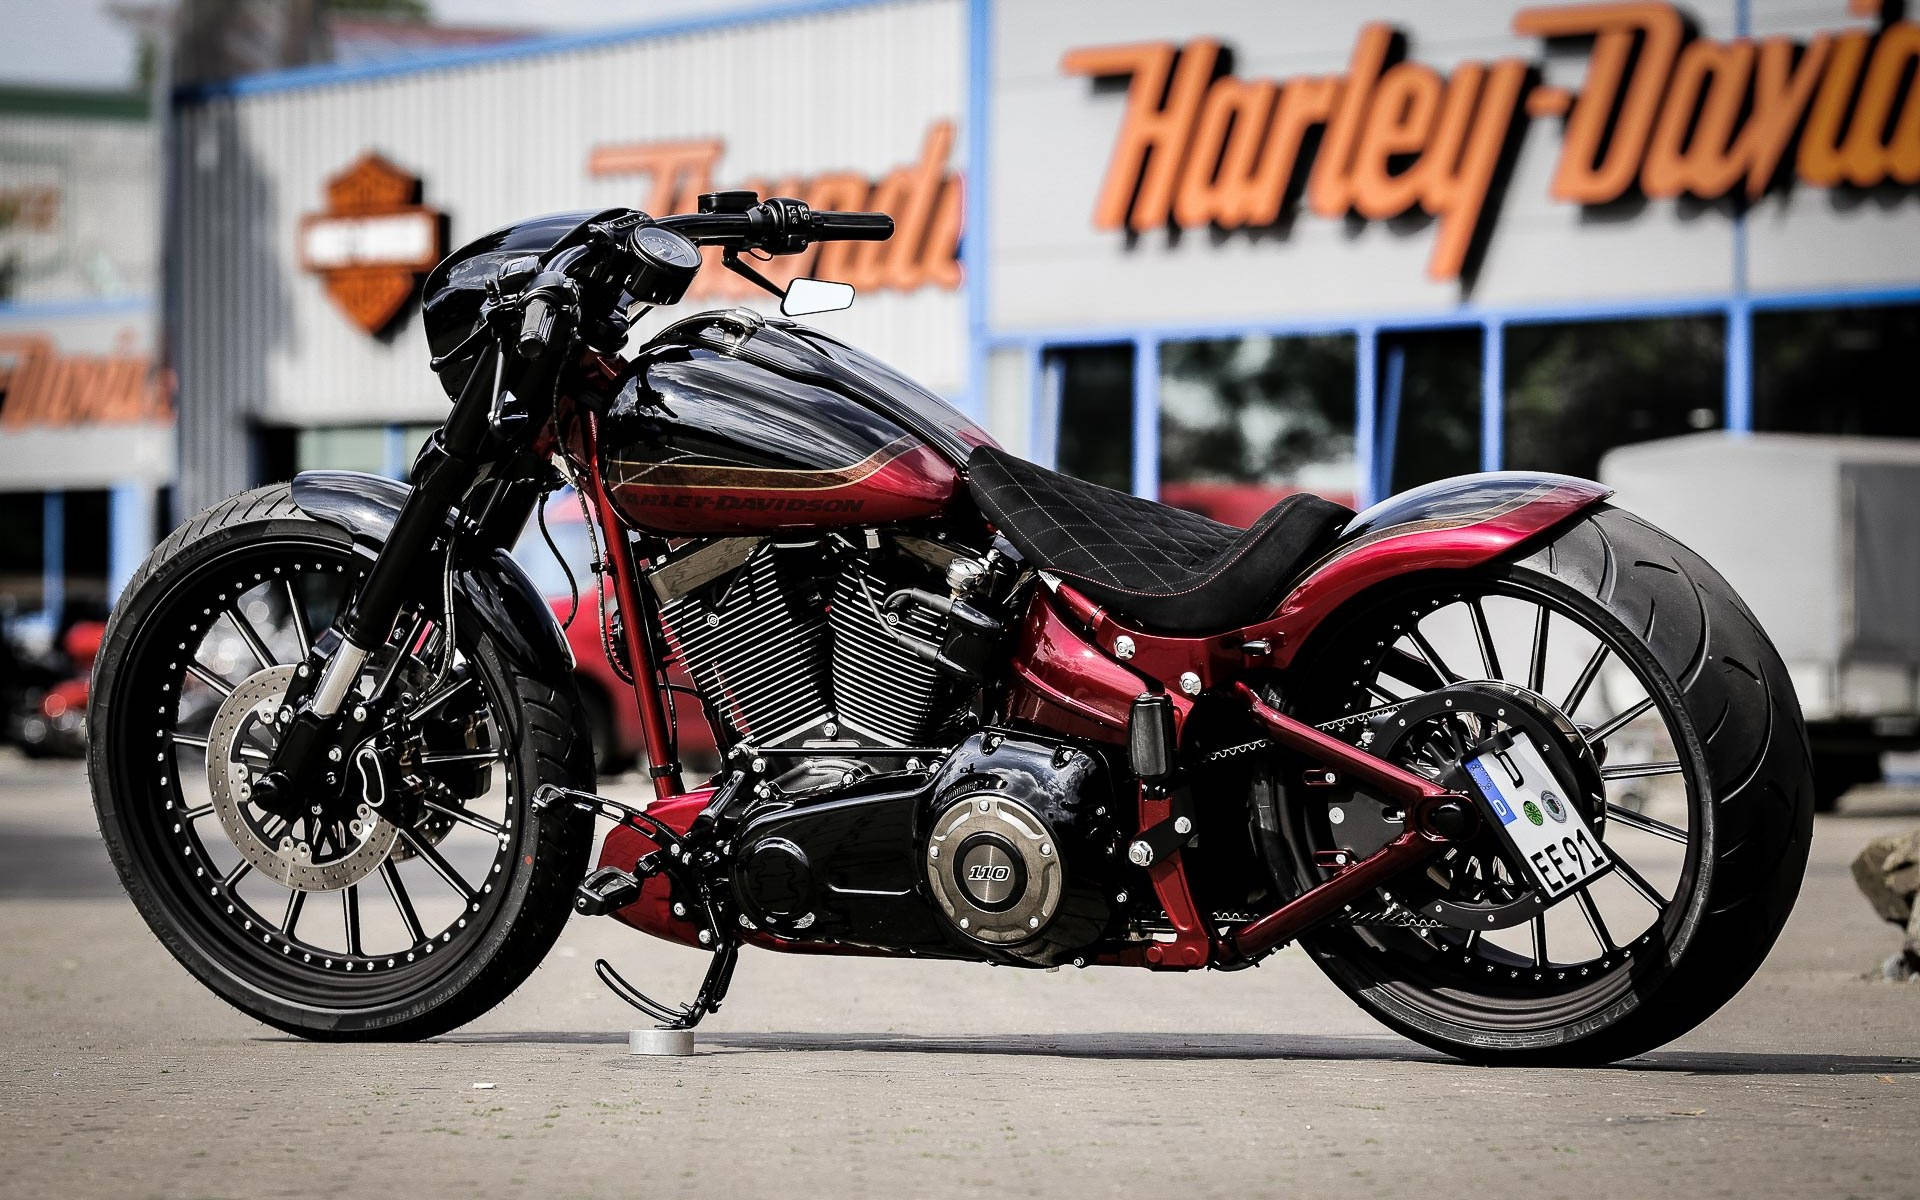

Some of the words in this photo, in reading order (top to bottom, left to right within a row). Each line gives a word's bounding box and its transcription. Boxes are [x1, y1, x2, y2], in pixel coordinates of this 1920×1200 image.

[621, 492, 866, 513] ARLEY-DAVIDSON
[1492, 799, 1507, 817] D
[968, 865, 1010, 881] 110
